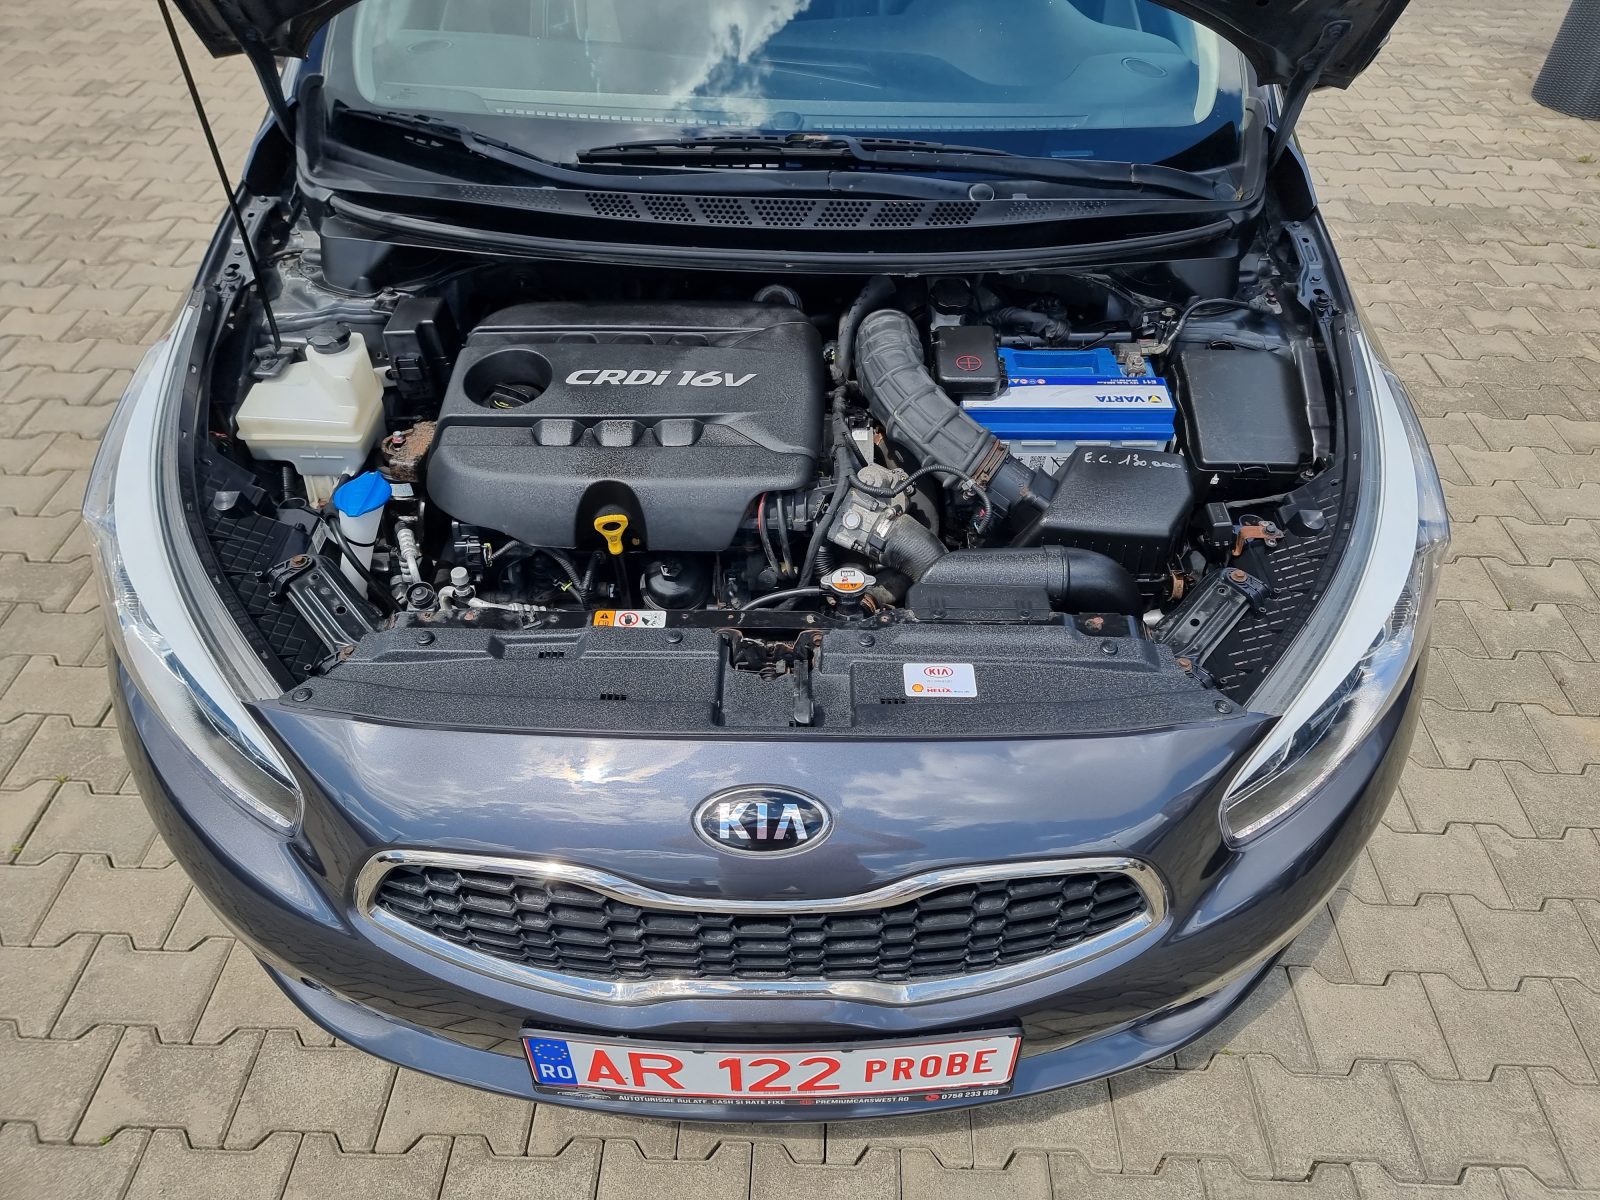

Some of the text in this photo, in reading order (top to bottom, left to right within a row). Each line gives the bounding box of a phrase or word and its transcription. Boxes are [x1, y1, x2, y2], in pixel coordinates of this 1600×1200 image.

[565, 369, 758, 387] CRDi 16V
[1095, 395, 1146, 403] VARTA
[719, 802, 808, 840] KIA
[540, 1063, 573, 1080] RO
[587, 1049, 998, 1092] AR 122 PROBE
[618, 1095, 674, 1104] AUTOTURISME
